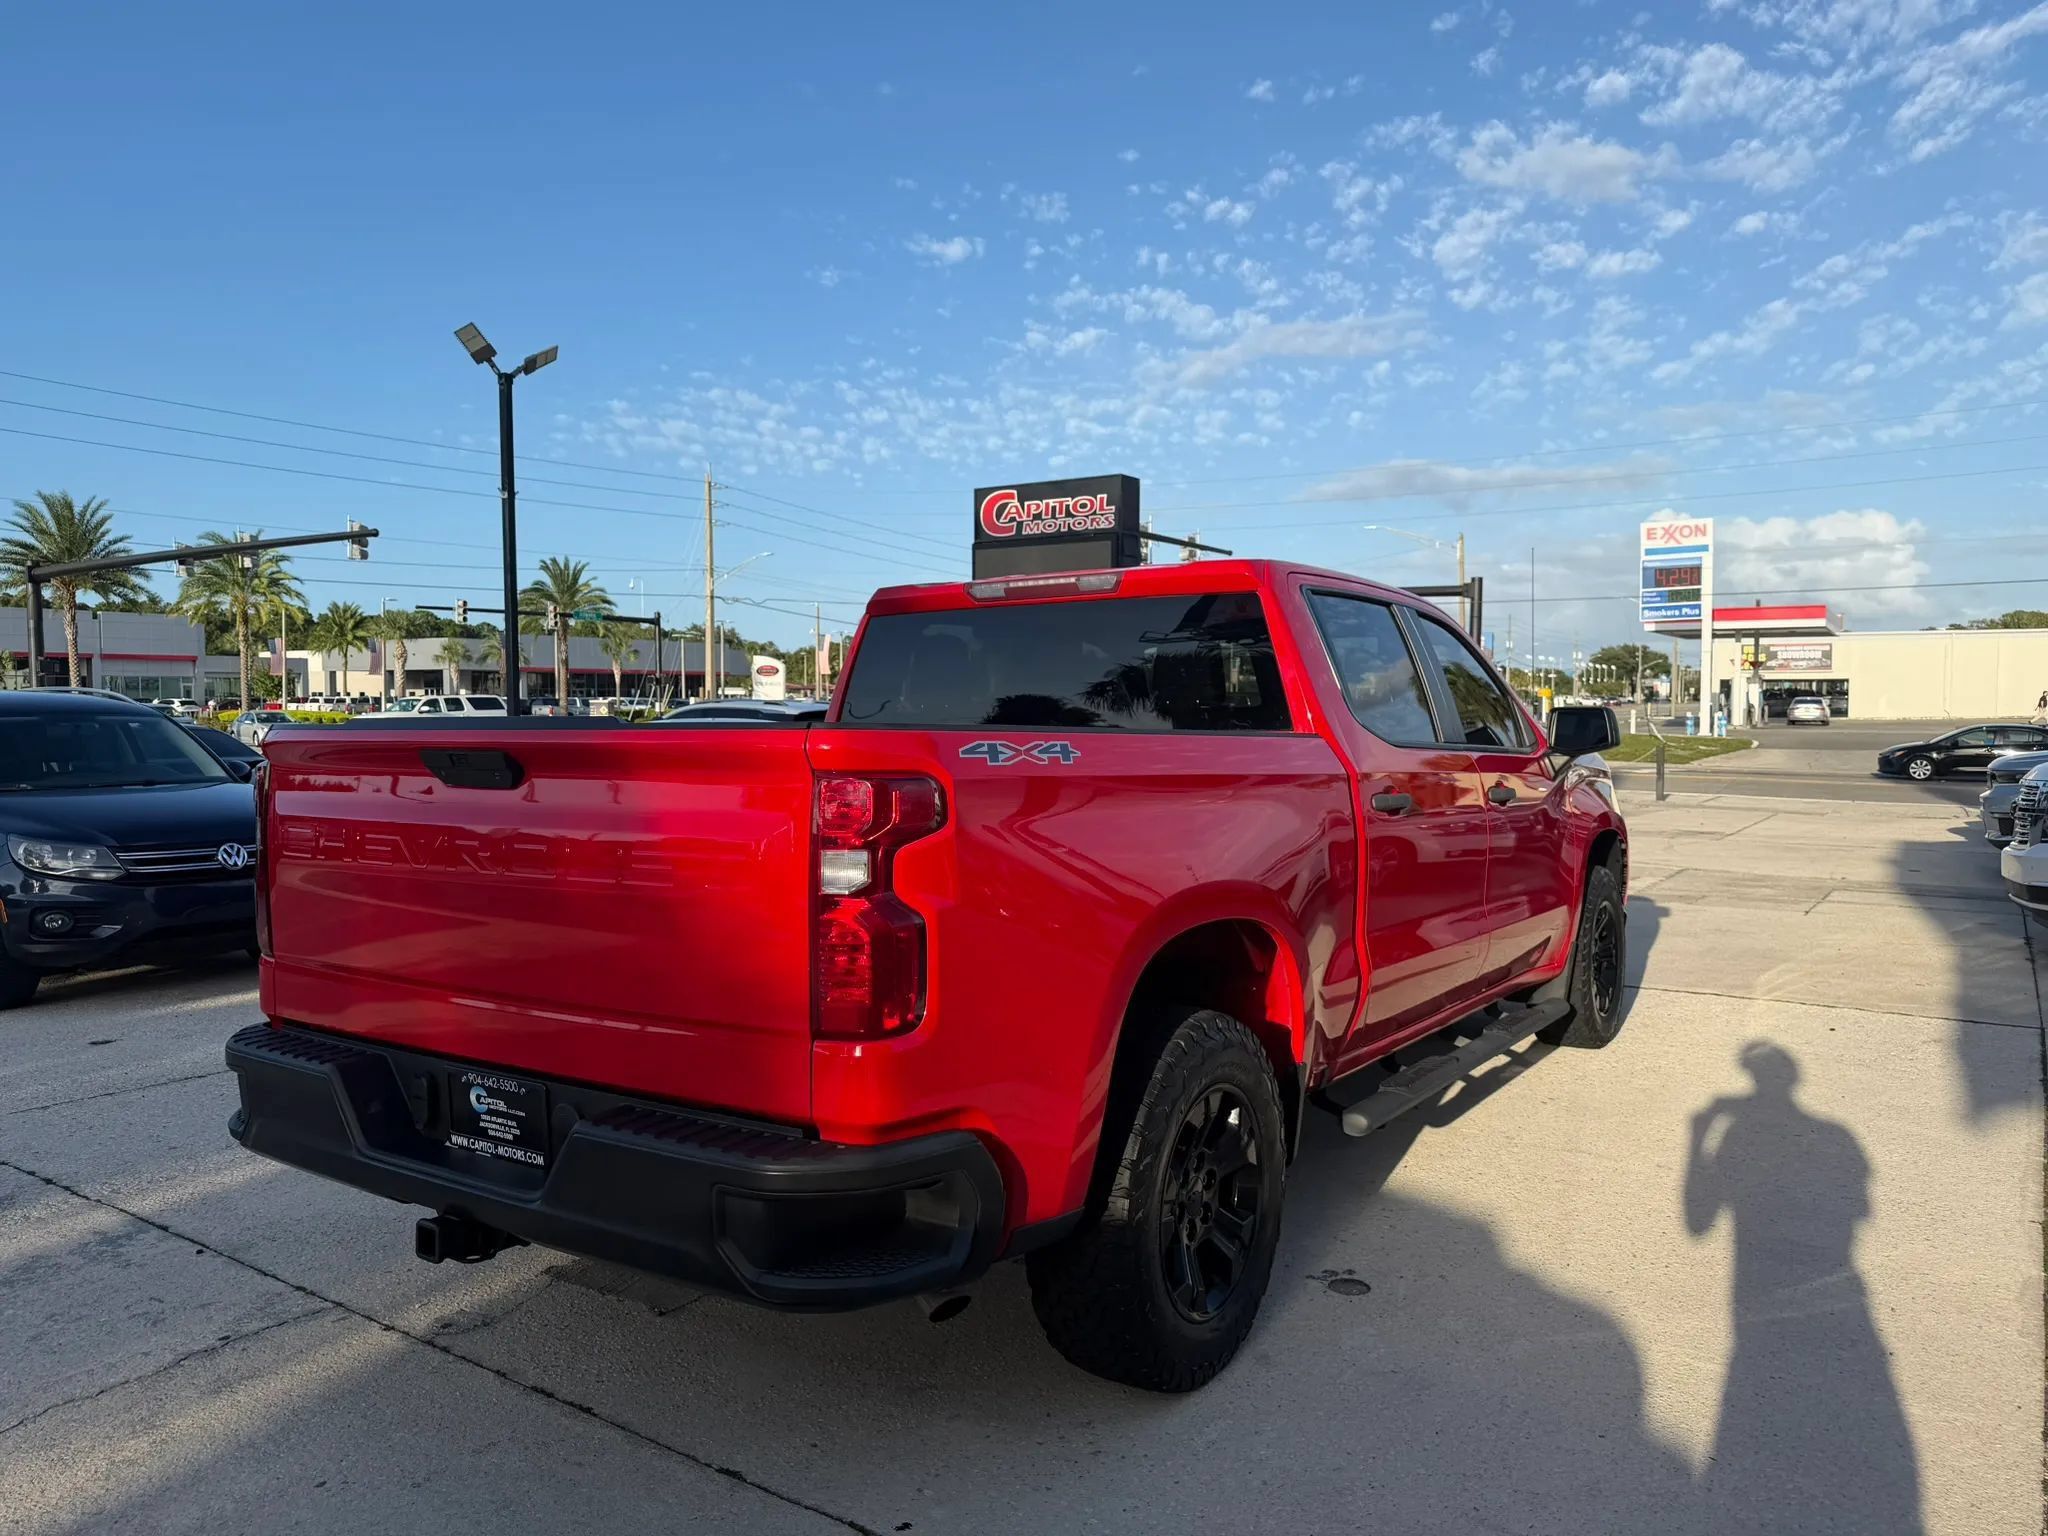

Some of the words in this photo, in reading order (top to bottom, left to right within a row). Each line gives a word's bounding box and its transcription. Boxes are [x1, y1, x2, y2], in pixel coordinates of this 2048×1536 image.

[980, 489, 1116, 537] CAPITOL
[1022, 514, 1116, 535] MOTORS
[1646, 523, 1707, 544] EXXON
[1643, 607, 1680, 618] Smokers
[1682, 606, 1700, 616] Plus
[958, 740, 1082, 765] 4X4
[468, 1073, 518, 1093] 904-642-5500
[470, 1086, 507, 1113] CAPITOL
[451, 1134, 545, 1166] WWW.CAPITOL-MOTORS.COM
